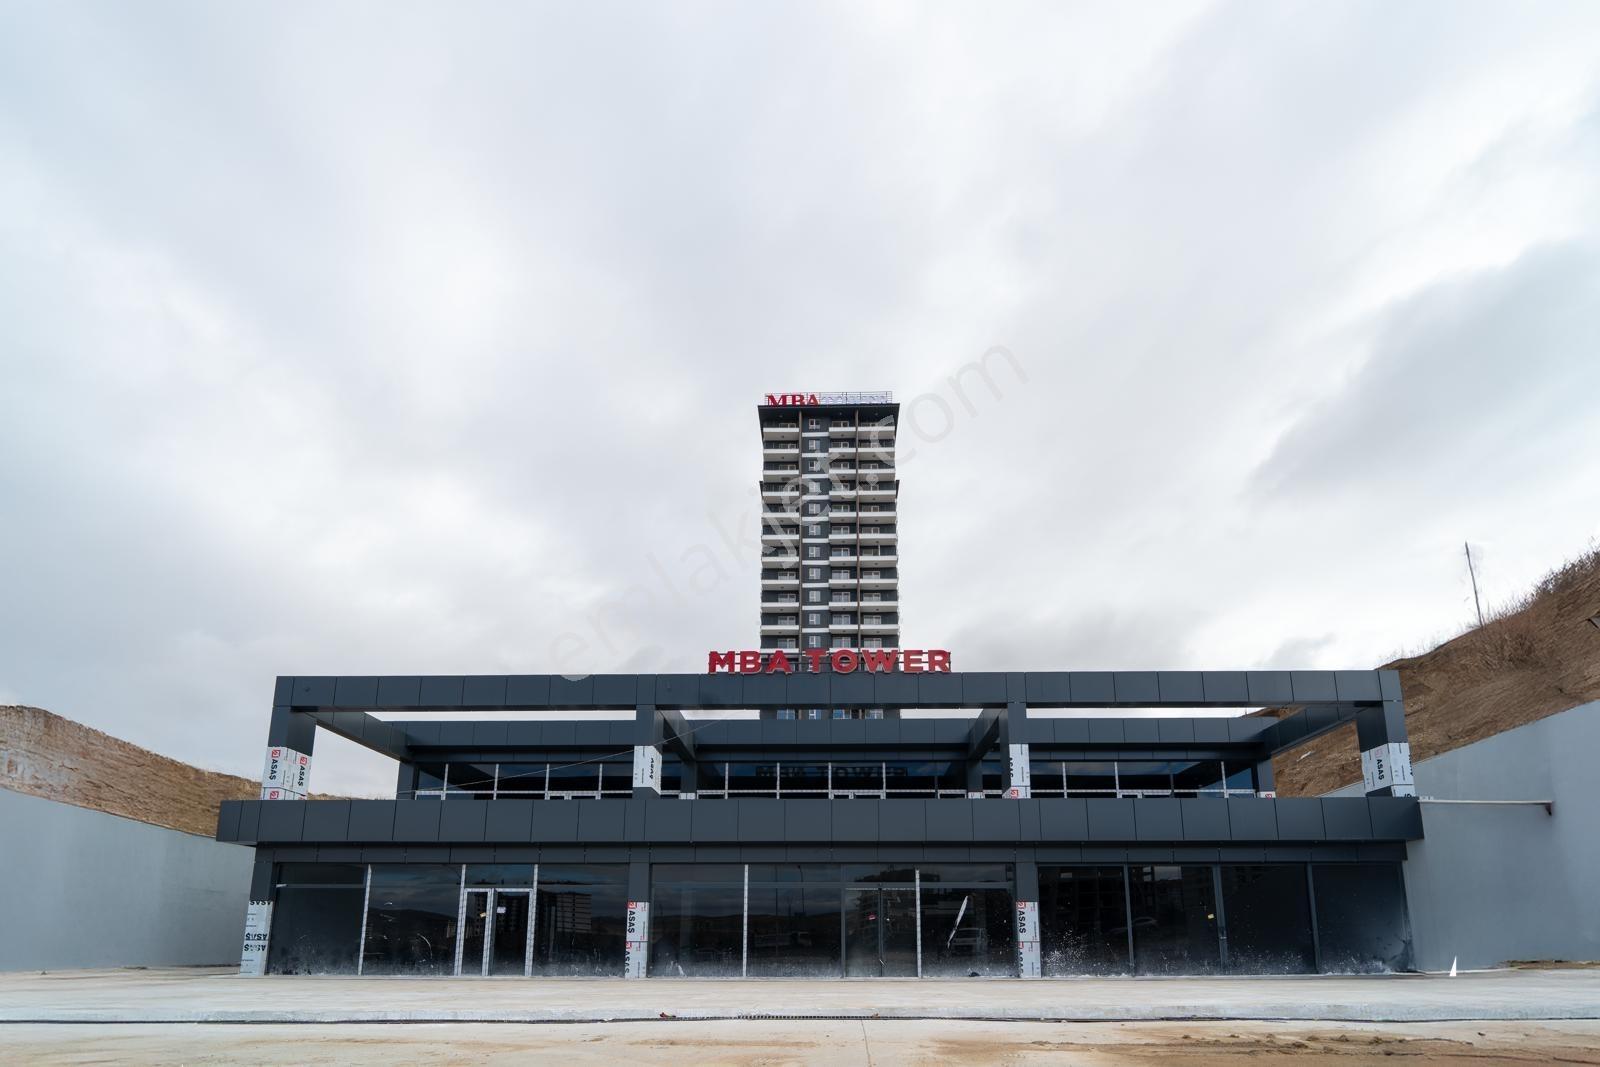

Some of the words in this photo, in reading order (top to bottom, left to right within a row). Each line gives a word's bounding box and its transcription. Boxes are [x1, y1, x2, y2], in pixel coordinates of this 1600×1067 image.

[766, 393, 819, 407] MBA
[708, 650, 792, 674] MBA
[803, 648, 951, 674] TOWER
